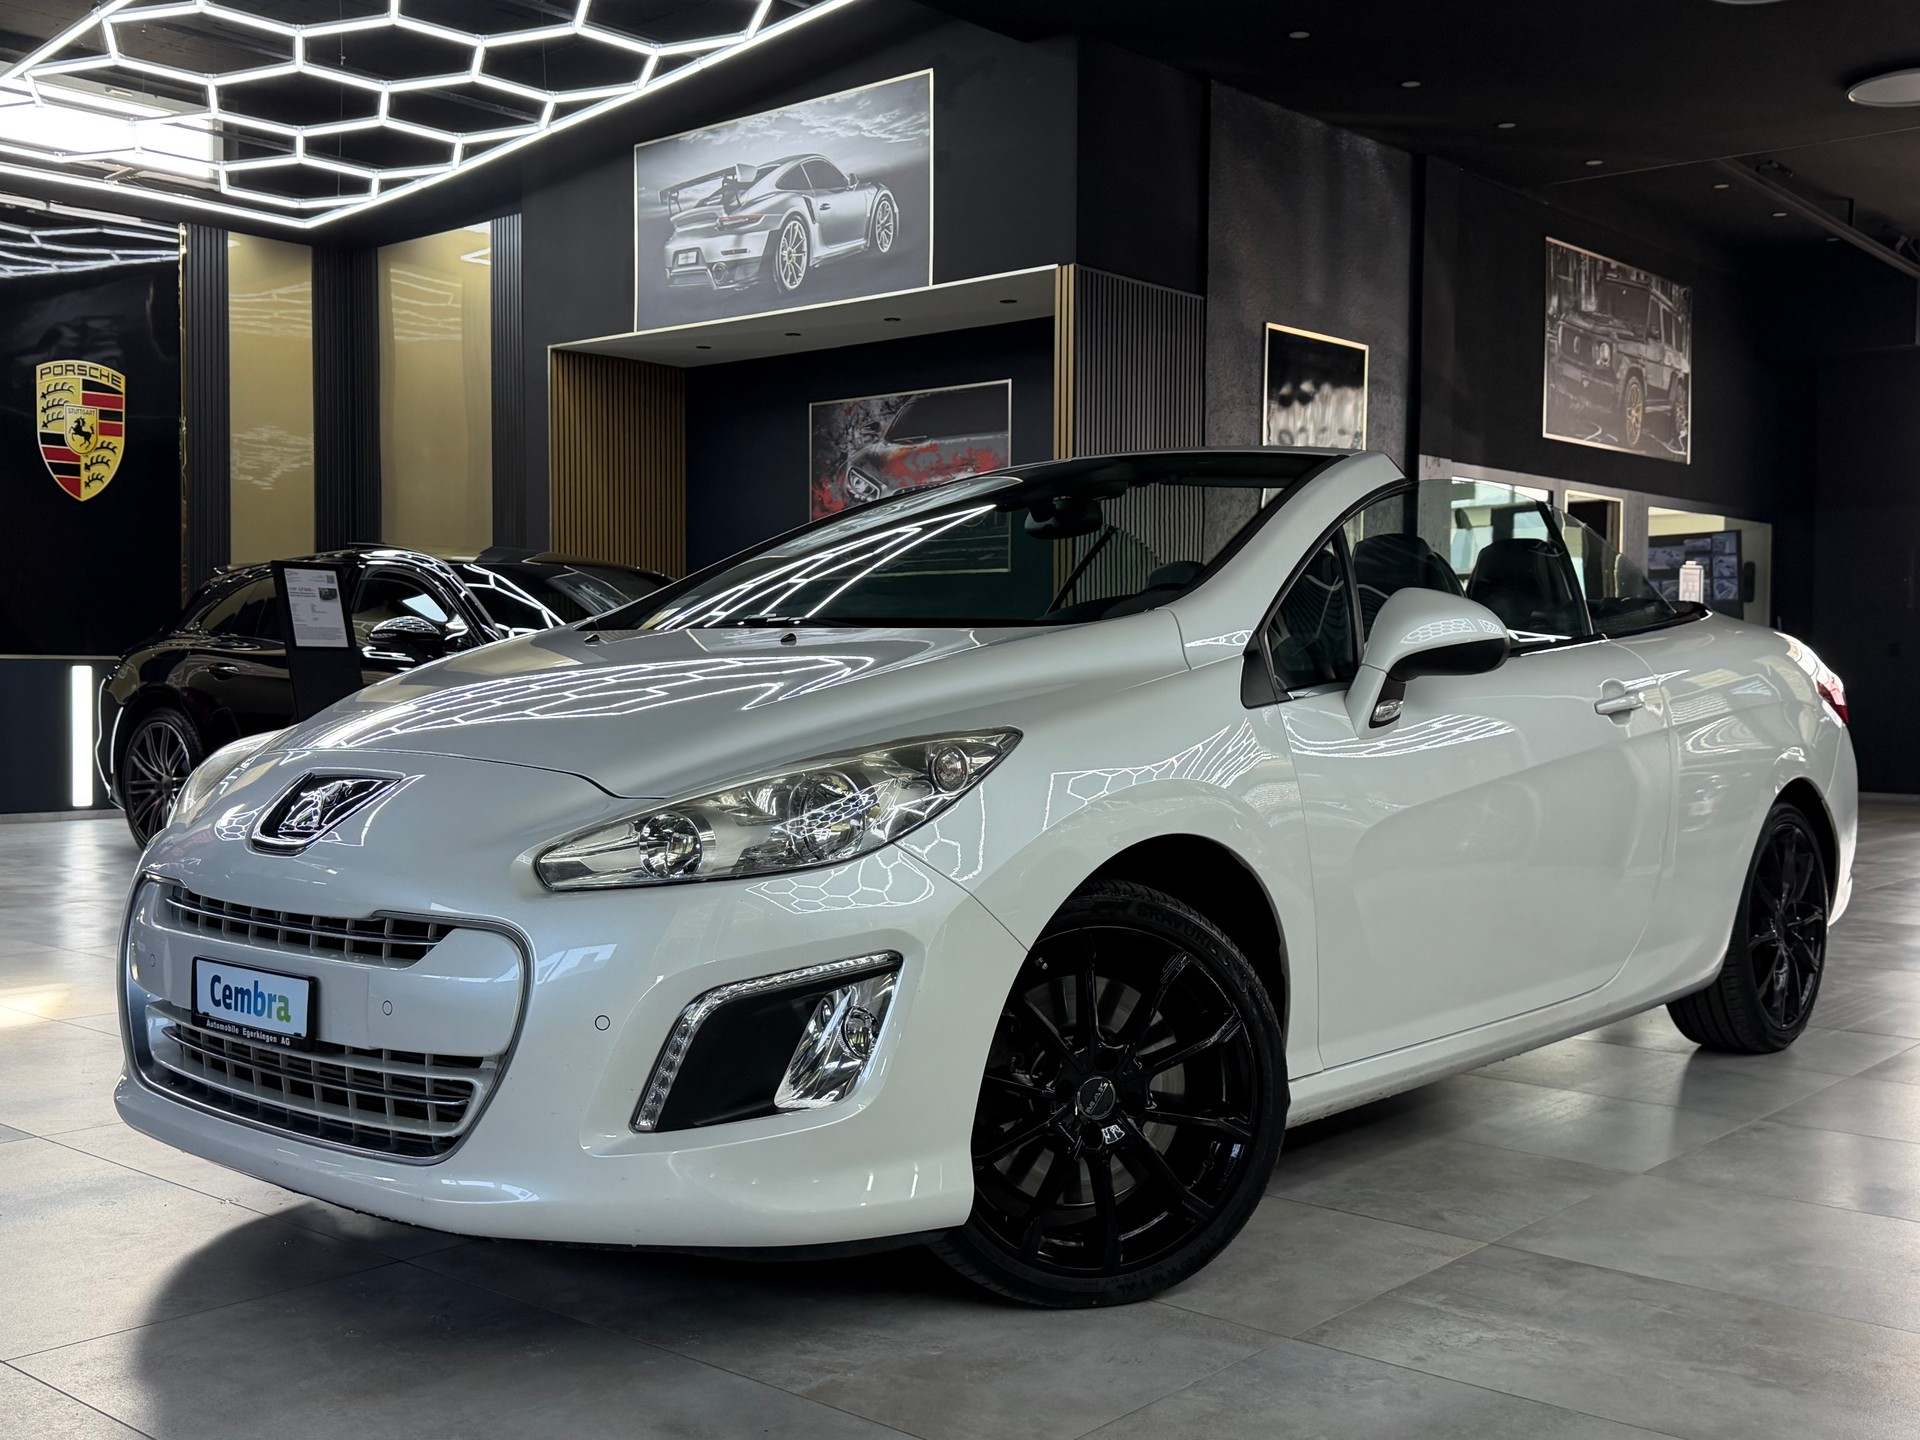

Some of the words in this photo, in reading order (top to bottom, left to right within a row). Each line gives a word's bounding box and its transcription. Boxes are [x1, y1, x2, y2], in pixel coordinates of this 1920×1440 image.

[40, 364, 121, 388] PORSCHE
[67, 407, 95, 416] STUTTGART
[210, 974, 292, 1023] Cembra
[206, 1019, 239, 1034] Automobile
[242, 1027, 278, 1043] Egerkingen
[281, 1036, 291, 1046] AG
[1085, 1082, 1109, 1113] MAK
